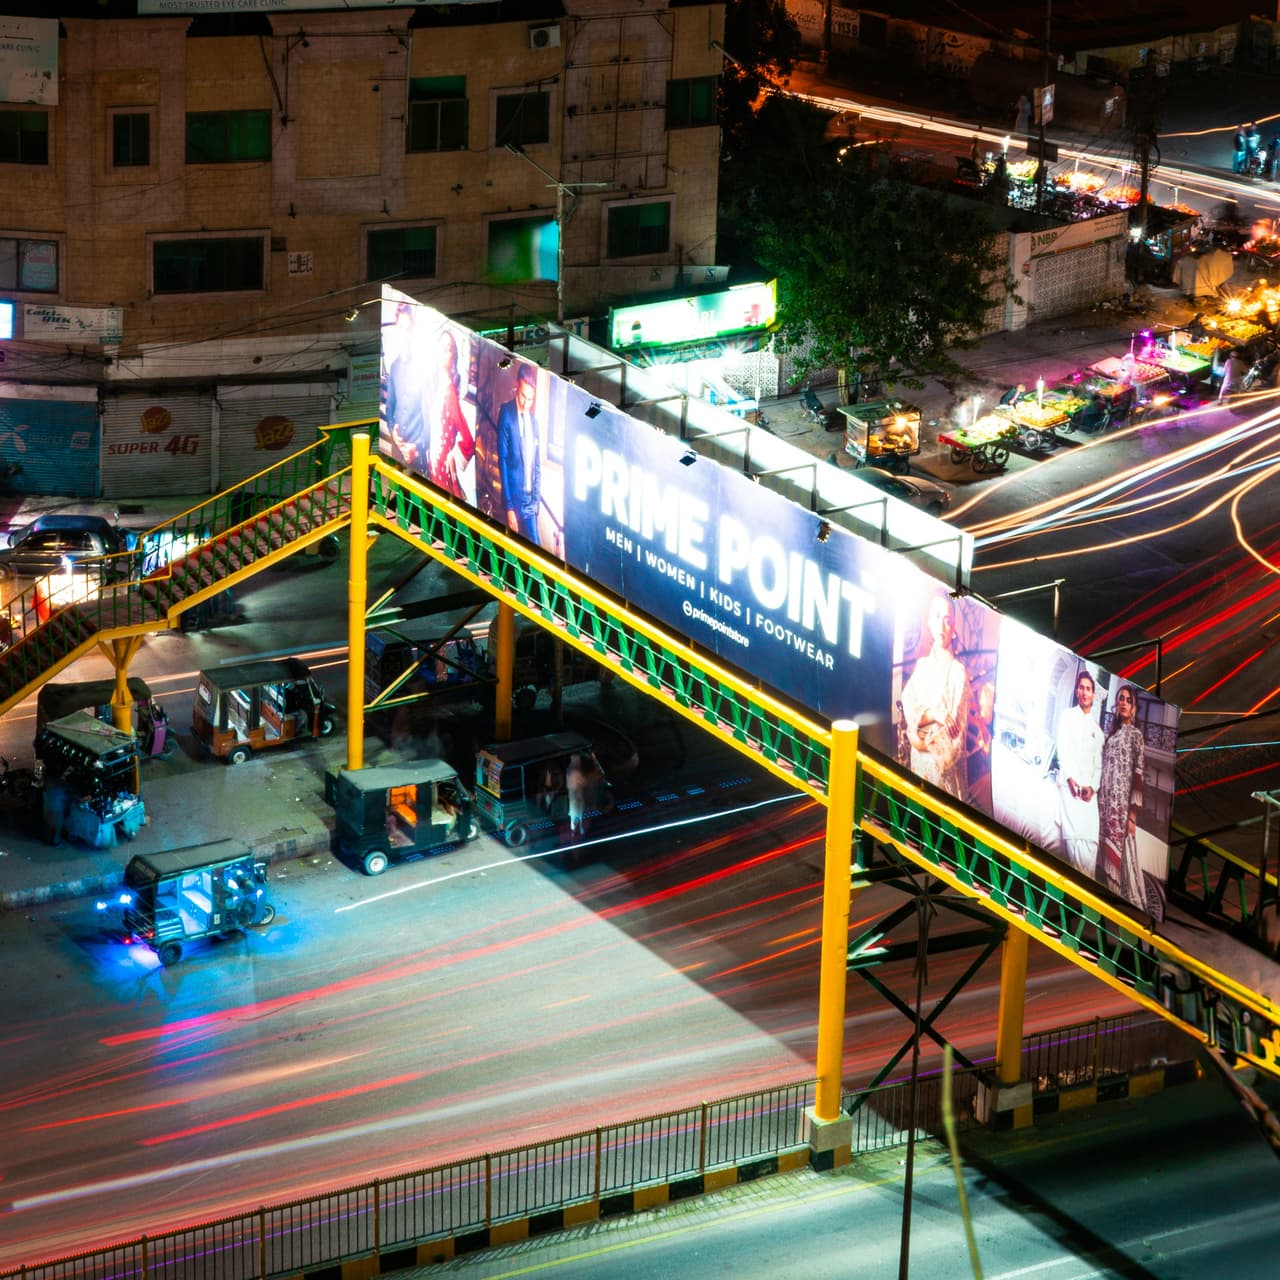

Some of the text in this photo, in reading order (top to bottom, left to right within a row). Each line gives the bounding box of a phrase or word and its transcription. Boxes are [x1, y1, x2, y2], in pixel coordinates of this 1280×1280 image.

[159, 1, 182, 10] MOST
[185, 0, 221, 9] TRUSTED
[222, 0, 236, 9] EYE
[237, 0, 257, 8] CARE
[16, 43, 41, 54] CLINIC
[1037, 231, 1058, 247] NBP
[107, 434, 200, 456] SUPER 4G
[255, 423, 296, 451] Jazz
[574, 434, 876, 659] PRIME POINT
[605, 526, 834, 671] MEN WOMEN KIDS FOOTWEAR
